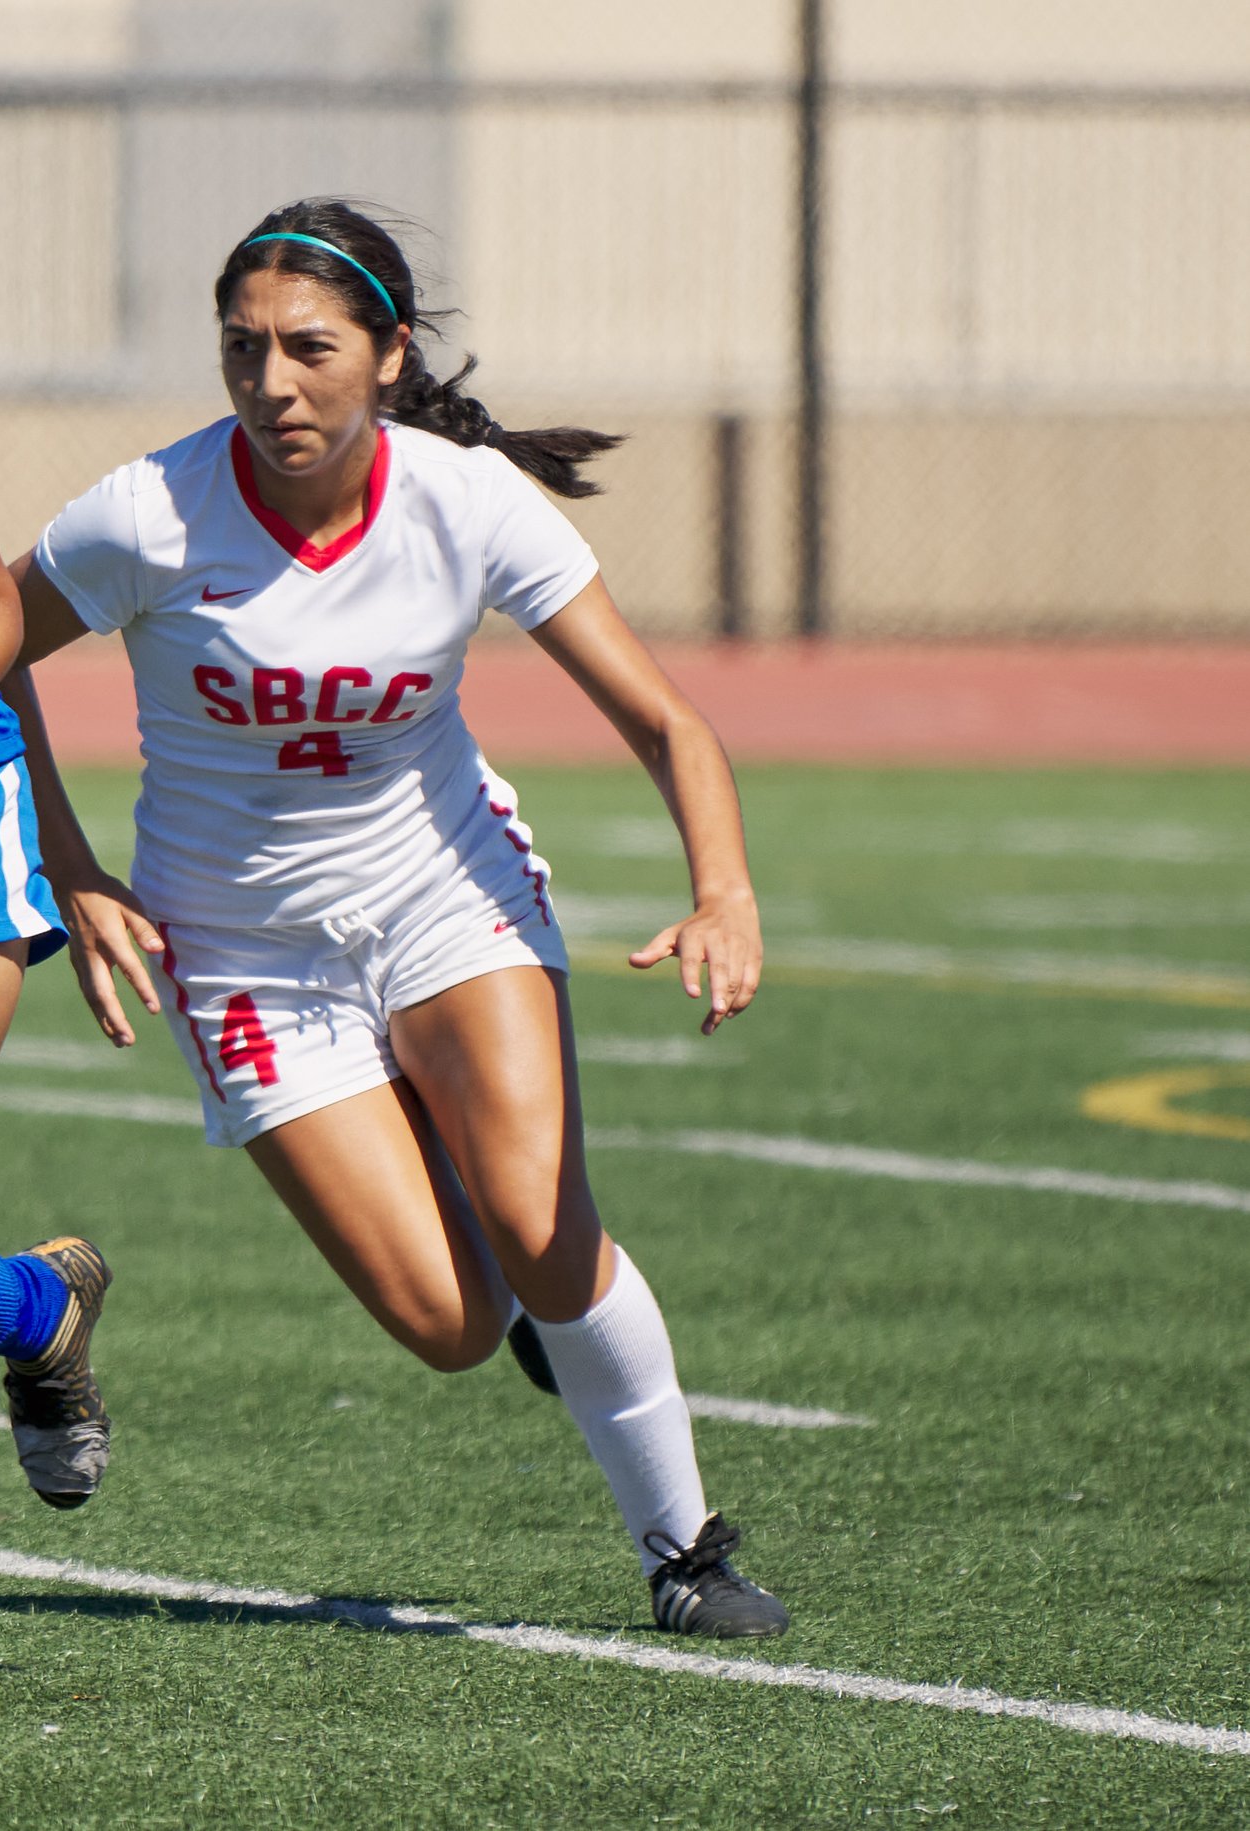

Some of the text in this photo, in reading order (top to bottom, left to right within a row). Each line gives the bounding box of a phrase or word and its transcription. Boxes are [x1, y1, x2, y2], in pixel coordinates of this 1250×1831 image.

[193, 664, 433, 726] SBCC
[278, 731, 355, 777] 4
[218, 992, 280, 1088] 4
